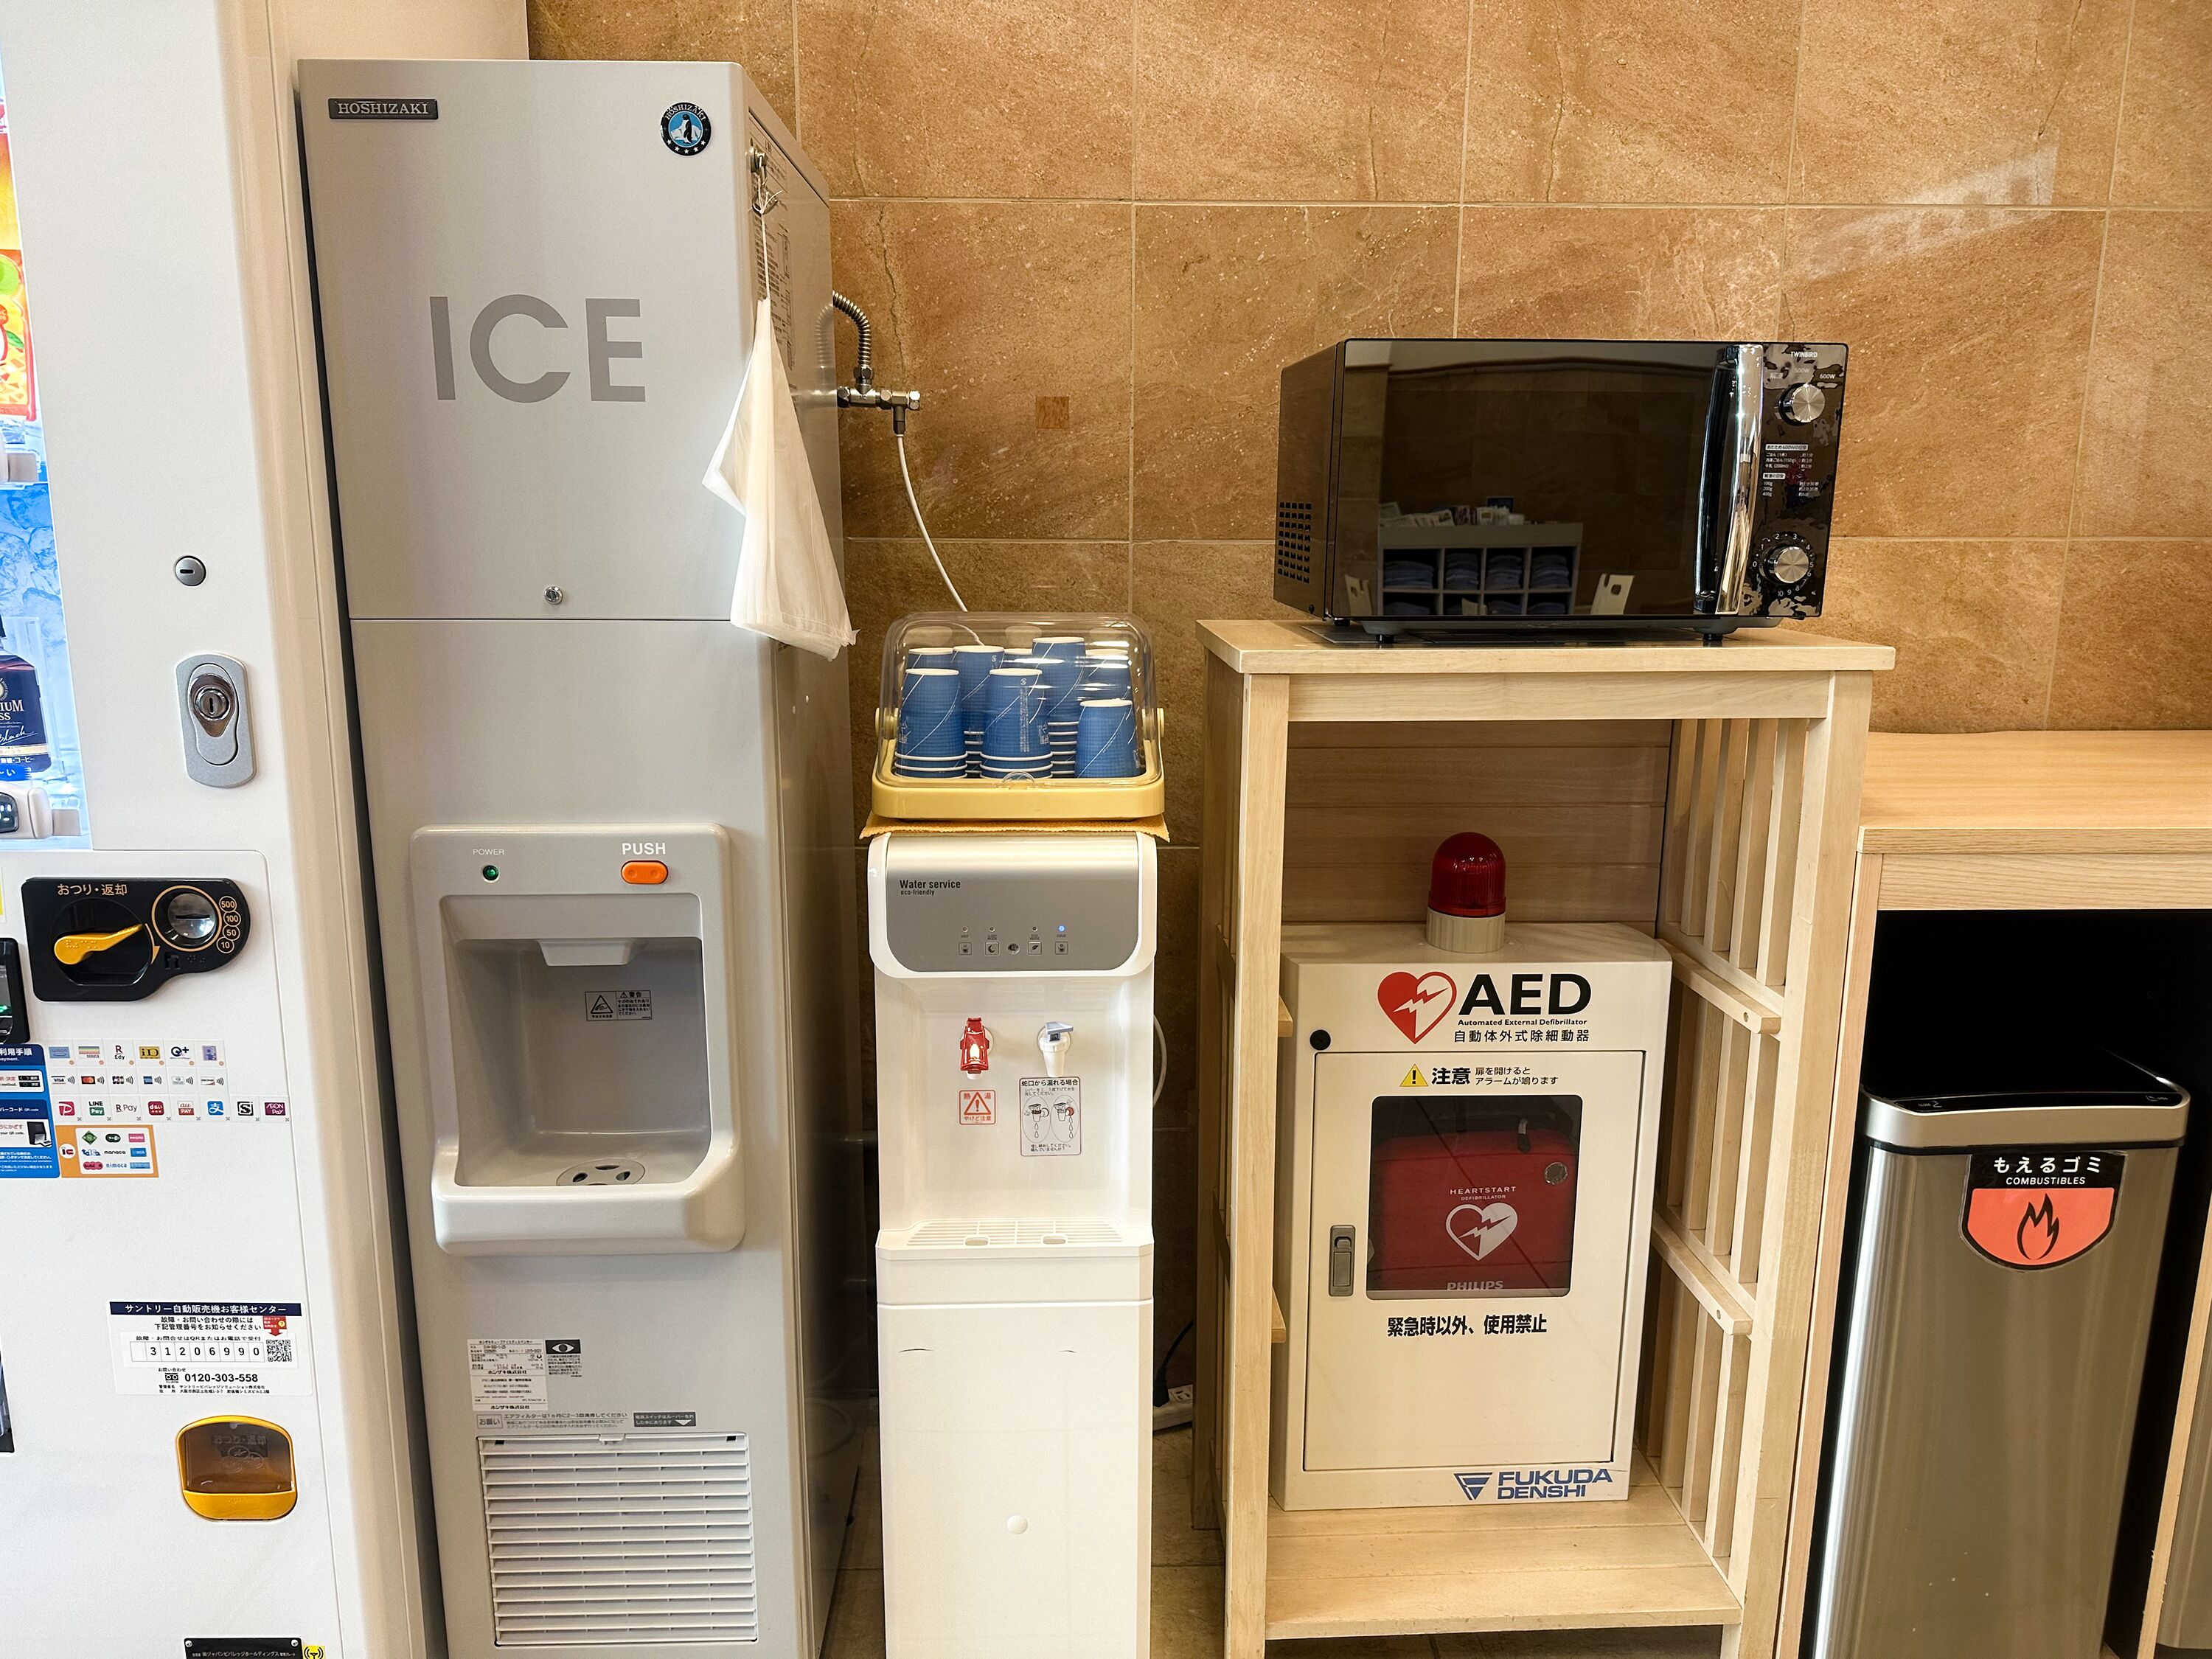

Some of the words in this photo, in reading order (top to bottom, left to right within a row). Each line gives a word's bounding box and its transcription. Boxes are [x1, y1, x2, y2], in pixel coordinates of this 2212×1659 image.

[338, 101, 429, 115] HOSHIZAKI
[665, 104, 706, 121] HOSHIZAKI
[430, 294, 646, 403] ICE
[622, 843, 666, 855] PUSH
[58, 883, 128, 896] おつり・返却
[900, 880, 926, 888] Water
[929, 880, 961, 888] service
[1458, 973, 1591, 1015] AED
[1454, 1029, 1589, 1043] 自動体外式除細動器
[142, 1048, 159, 1057] iD
[1431, 1067, 1471, 1085] 注意
[1475, 1067, 1531, 1076] 扉を開けると
[1475, 1077, 1558, 1085] アラームが鳴ります
[1993, 1156, 2101, 1174] もえるゴミ
[2006, 1177, 2086, 1185] COMBUSTIBLES
[1450, 1186, 1517, 1194] HEARTSTART
[1447, 1281, 1504, 1291] PHILIPS
[125, 1304, 287, 1314] サントリー自動販売機お客様センター
[1387, 1315, 1547, 1337] 緊急時以外、使用禁止
[184, 1374, 258, 1382] 0120-303-558
[1498, 1469, 1613, 1486] FUKUDA
[1498, 1485, 1585, 1499] DENSHI
